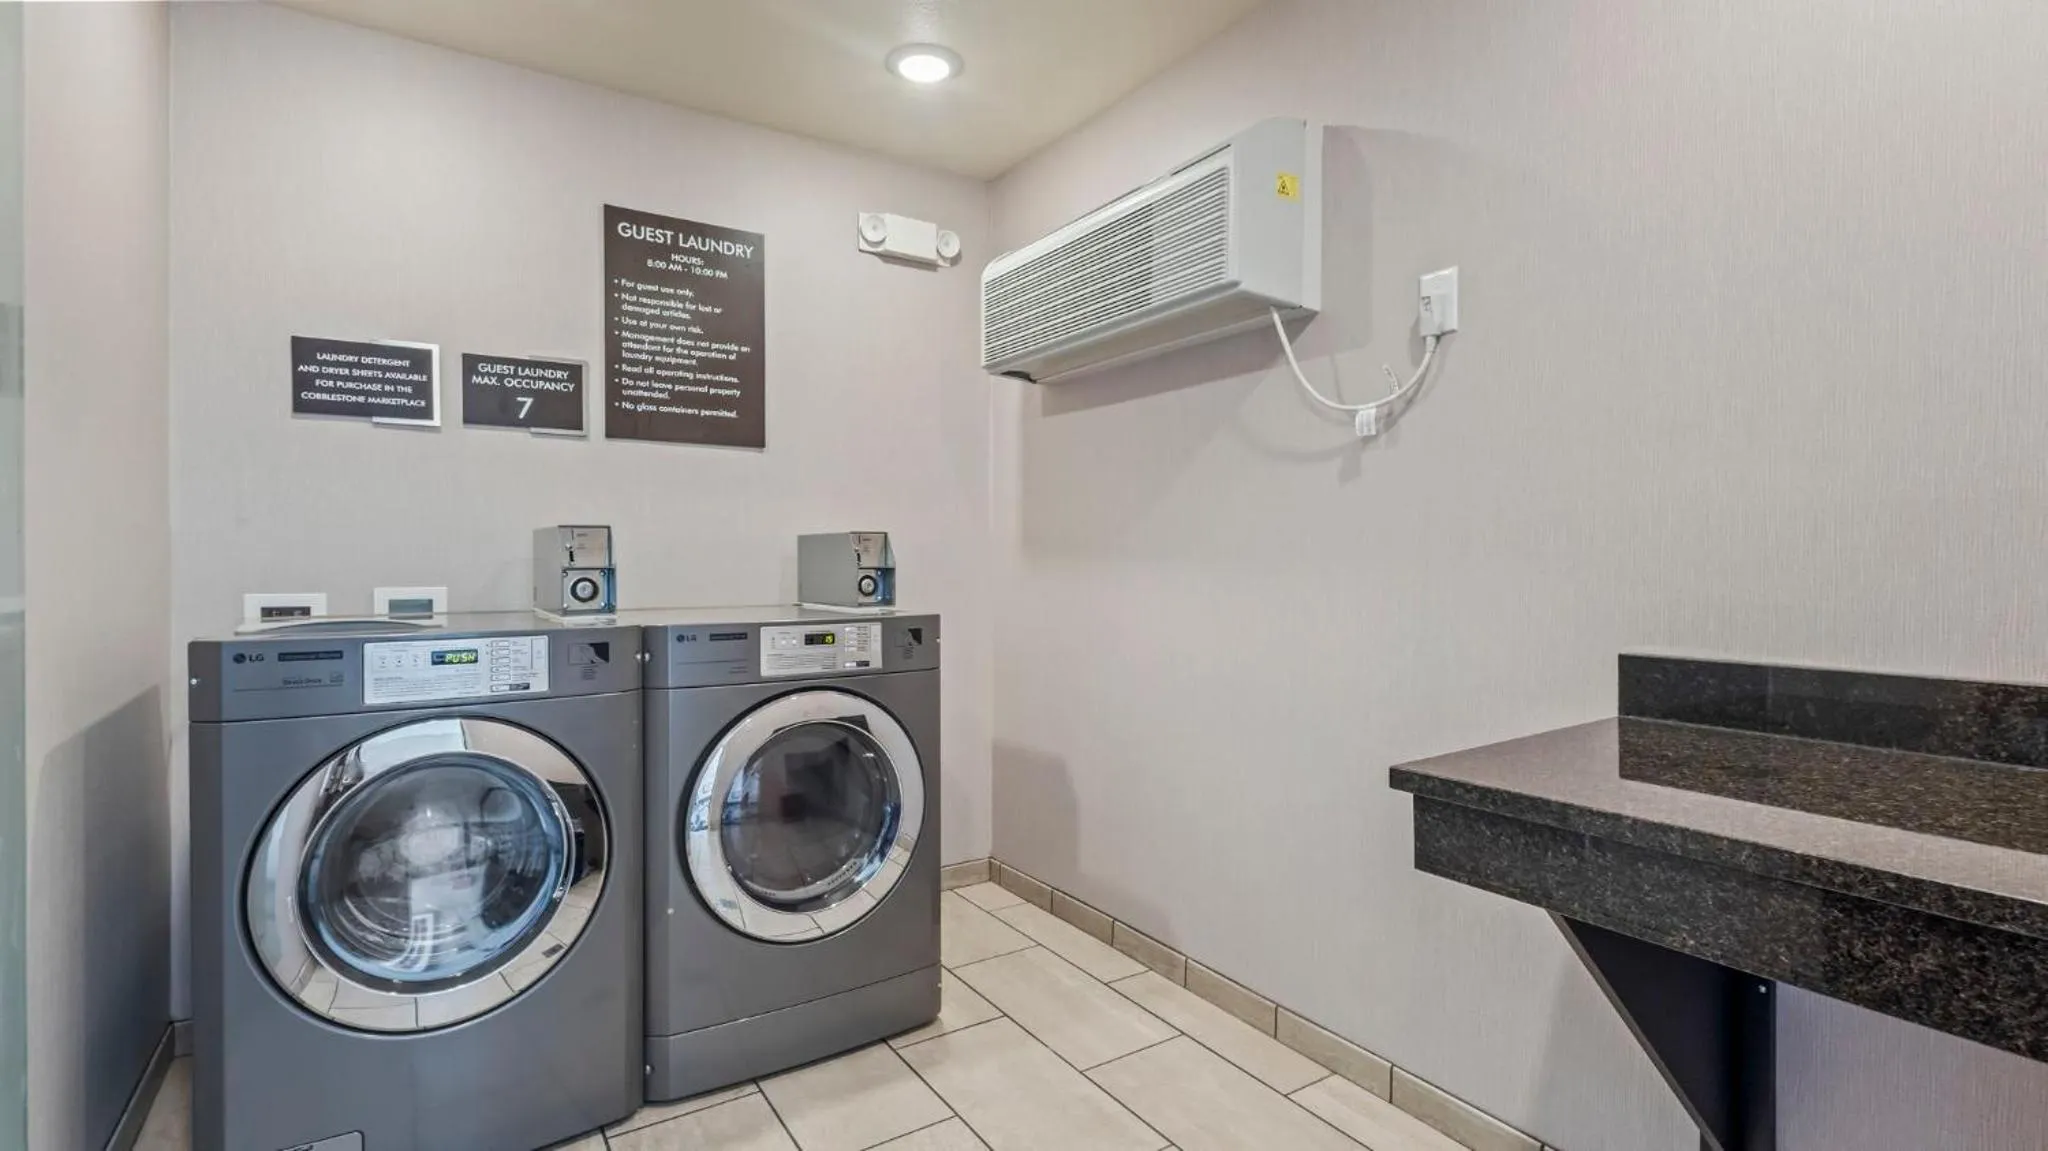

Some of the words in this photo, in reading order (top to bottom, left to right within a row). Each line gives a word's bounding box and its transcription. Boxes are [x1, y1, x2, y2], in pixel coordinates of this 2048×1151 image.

[617, 222, 674, 245] GUEST
[678, 233, 754, 259] LAUNDRY
[671, 253, 704, 266] HOURS:
[647, 259, 666, 269] 8:00
[668, 263, 682, 272] AM
[691, 267, 713, 278] 10:00
[715, 270, 728, 279] PM
[621, 278, 635, 288] For
[637, 283, 658, 291] guest
[676, 288, 695, 298] only.
[621, 293, 637, 301] Not
[639, 297, 683, 309] responsible
[685, 301, 696, 310] for
[698, 303, 712, 313] lost
[622, 302, 660, 315] damaged
[662, 310, 692, 319] articles.
[621, 316, 637, 325] Use
[649, 321, 667, 329] your
[669, 324, 686, 332] own
[688, 326, 704, 334] risk.
[621, 330, 674, 343] Management
[676, 337, 695, 347] does
[711, 342, 739, 352] provide
[316, 352, 358, 363] LAUNDRY
[361, 356, 410, 367] DETERGENT
[622, 341, 661, 351] attendant
[663, 344, 674, 353] for
[676, 346, 688, 355] the
[690, 350, 727, 360] operation
[729, 352, 737, 360] of
[622, 349, 653, 362] laundry
[298, 365, 319, 373] AND
[322, 366, 350, 376] DRYER
[352, 369, 383, 379] SHEETS
[385, 371, 428, 382] AVAILABLE
[478, 362, 516, 375] GUEST
[518, 366, 569, 380] LAUNDRY
[622, 363, 642, 373] Read
[644, 366, 654, 374] all
[656, 369, 694, 380] operating
[695, 372, 740, 383] instructions.
[315, 379, 335, 388] FOR
[336, 381, 383, 392] PURCHASE
[397, 386, 413, 394] THE
[472, 374, 501, 386] MAX.
[504, 377, 575, 393] OCCUPANCY
[622, 377, 634, 386] Do
[636, 380, 649, 388] not
[651, 380, 673, 390] leave
[675, 384, 708, 393] personal
[709, 387, 741, 398] property
[301, 391, 366, 403] COBBLESTONE
[367, 396, 426, 407] MARKETPLACE
[622, 389, 670, 400] unattended.
[516, 396, 534, 419] 7
[622, 401, 635, 410] No
[637, 402, 657, 412] glass
[659, 405, 699, 415] containers
[701, 409, 739, 418] permitted.
[249, 652, 265, 663] LG
[445, 652, 476, 663] PUSH
